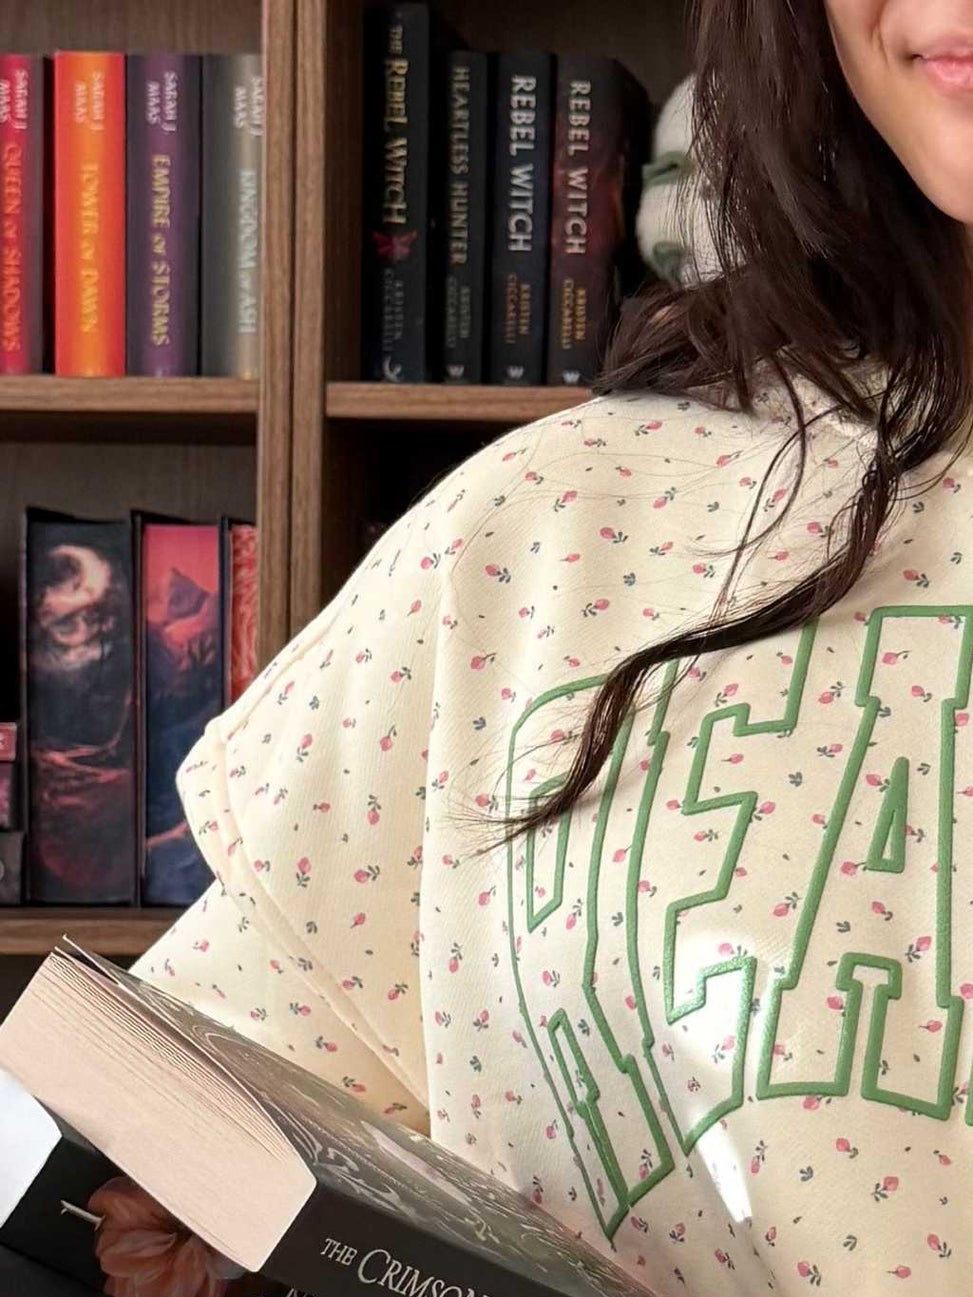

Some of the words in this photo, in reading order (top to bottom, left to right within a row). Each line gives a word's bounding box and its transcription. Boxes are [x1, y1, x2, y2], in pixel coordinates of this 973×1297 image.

[384, 58, 409, 132] REBEL
[449, 65, 470, 176] HEARTLESS
[509, 75, 537, 156] REBEL
[567, 80, 592, 156] REBEL
[3, 141, 21, 214] QUEEN
[80, 161, 98, 235] TOWER
[151, 154, 171, 228] EMPIRE
[382, 137, 409, 225] WITCH
[507, 165, 535, 253] WITCH
[564, 168, 590, 255] WITCH
[239, 169, 257, 269] KINGDOM
[449, 181, 469, 264] HUNTER
[2, 246, 21, 351] SHADOWS
[80, 268, 98, 333] DAWN
[151, 262, 171, 346] STORMS
[239, 291, 257, 333] ASH
[320, 1236, 358, 1266] THE
